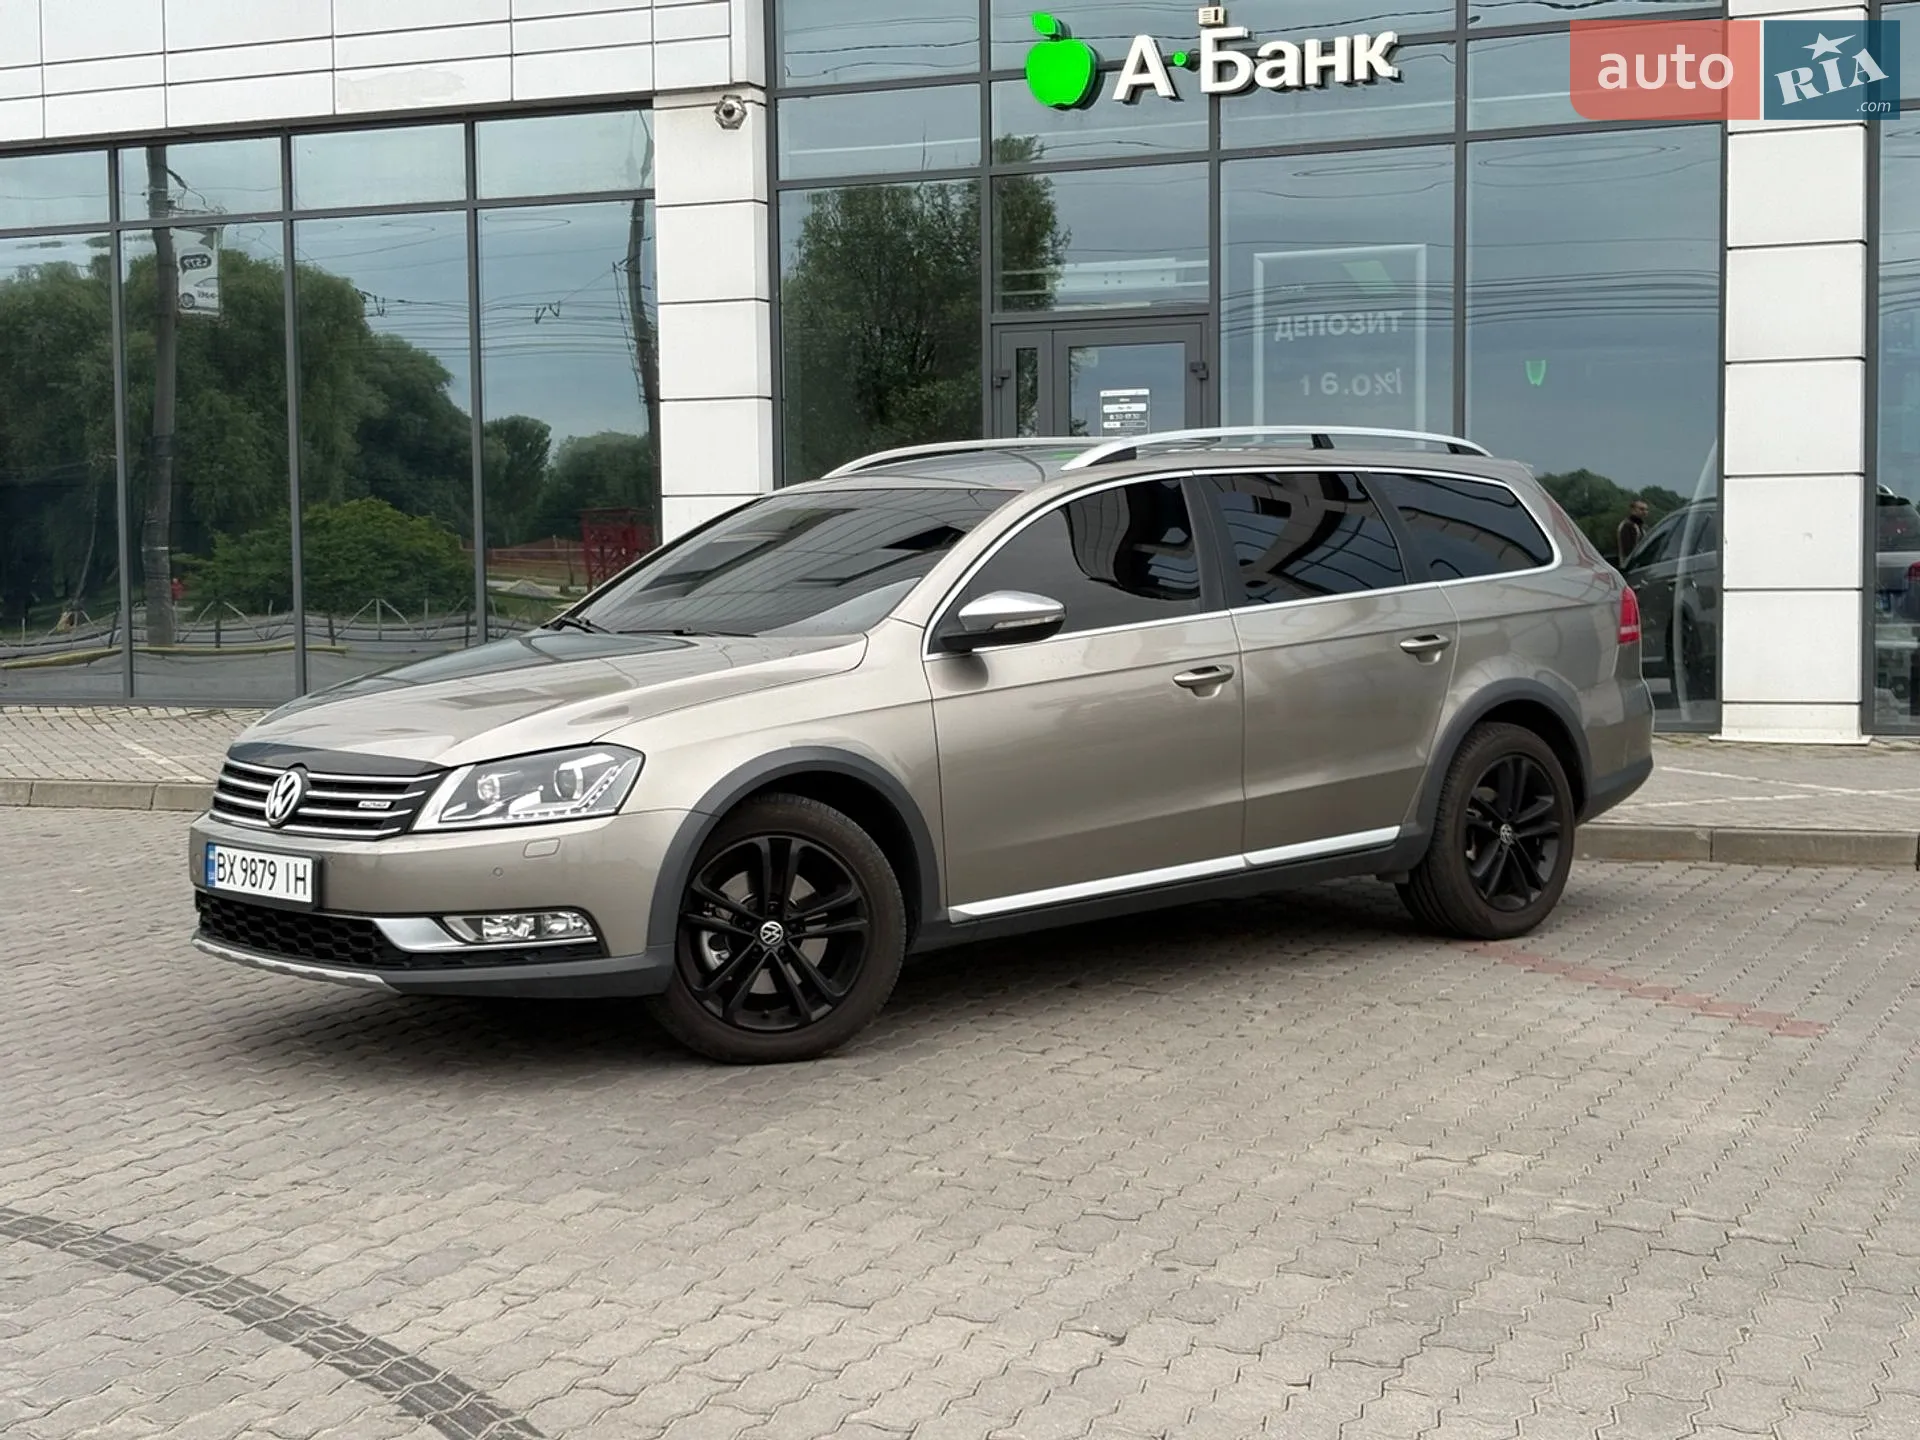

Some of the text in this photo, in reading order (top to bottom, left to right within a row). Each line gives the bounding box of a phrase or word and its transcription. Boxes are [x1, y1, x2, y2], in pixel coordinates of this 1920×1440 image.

[1274, 311, 1403, 342] ДЕПОЗИТ
[240, 856, 277, 891] 9879
[285, 862, 307, 896] IH
